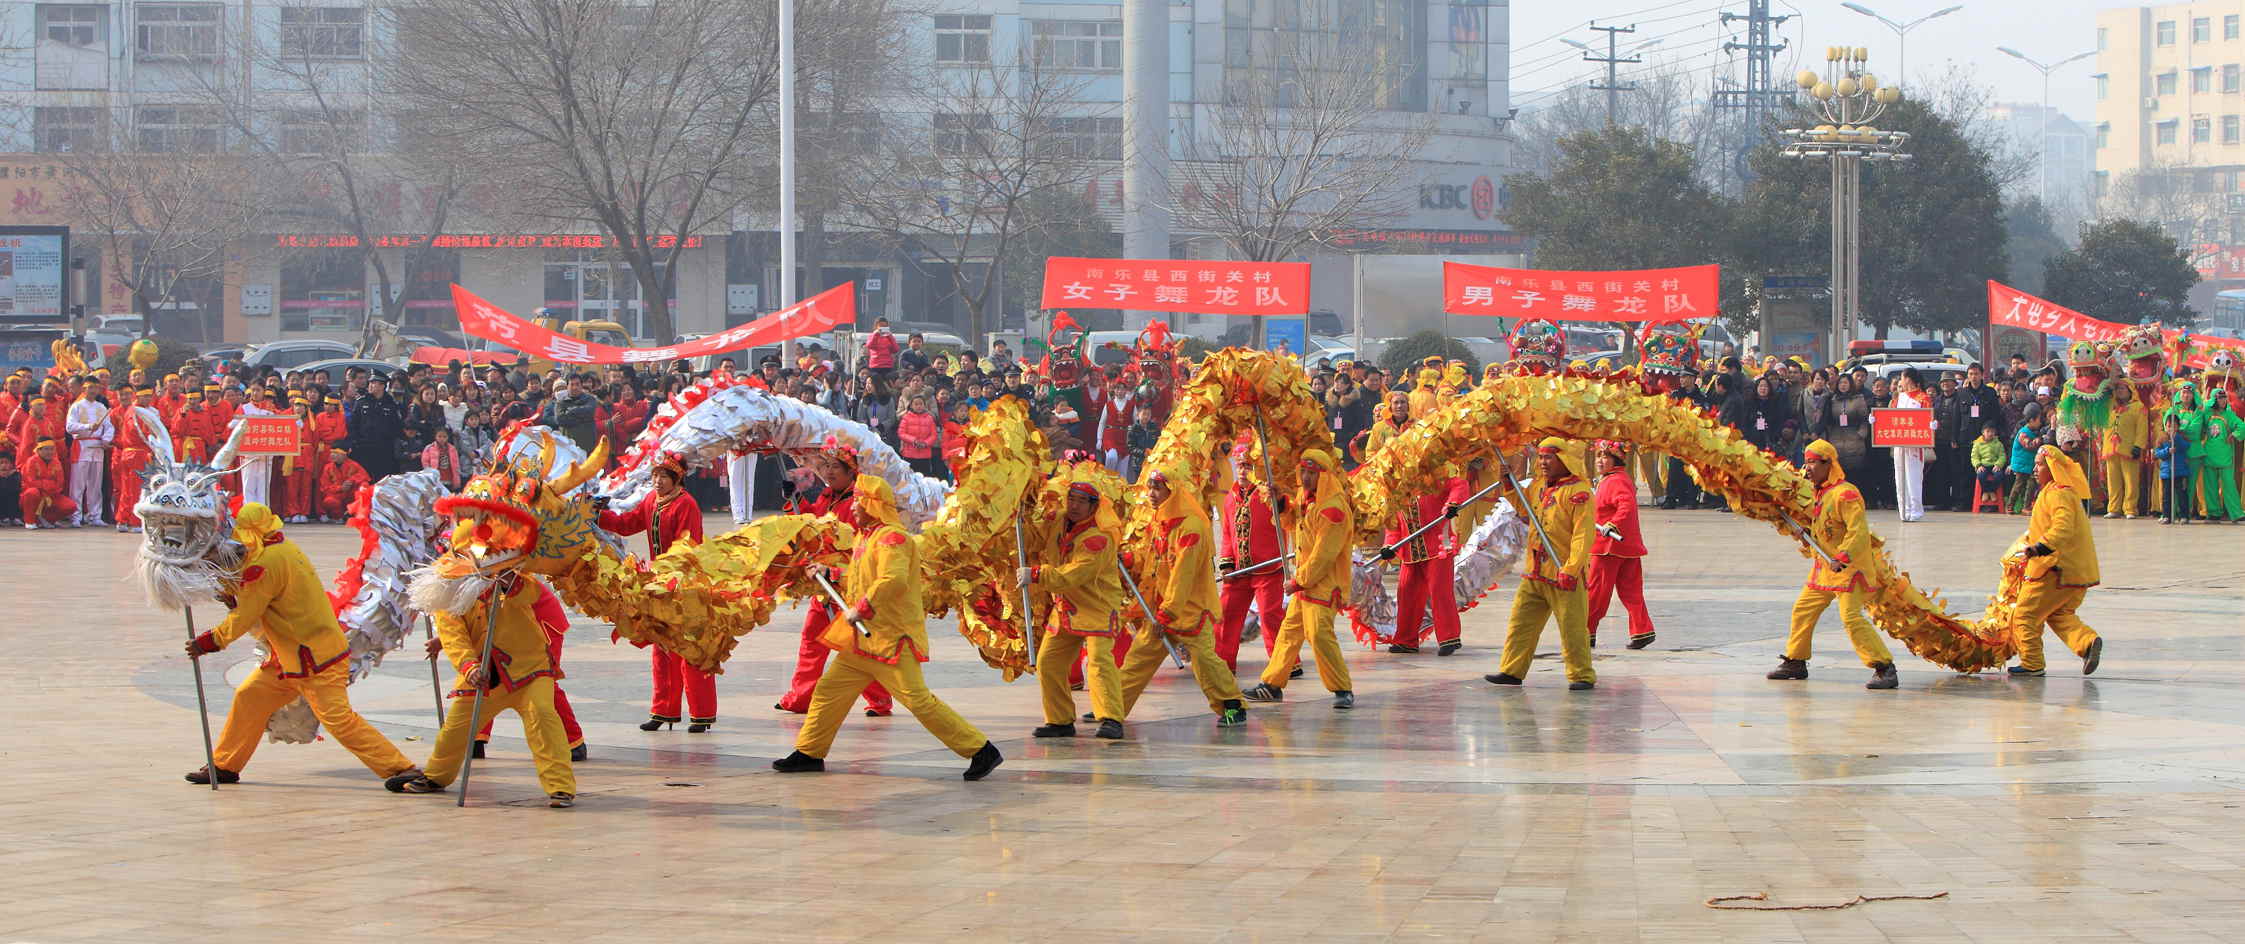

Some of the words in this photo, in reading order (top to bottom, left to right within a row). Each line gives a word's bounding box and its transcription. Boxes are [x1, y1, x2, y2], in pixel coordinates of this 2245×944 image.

[1062, 281, 1289, 306] 女子舞龙队
[1461, 286, 1697, 313] 男子舞龙队
